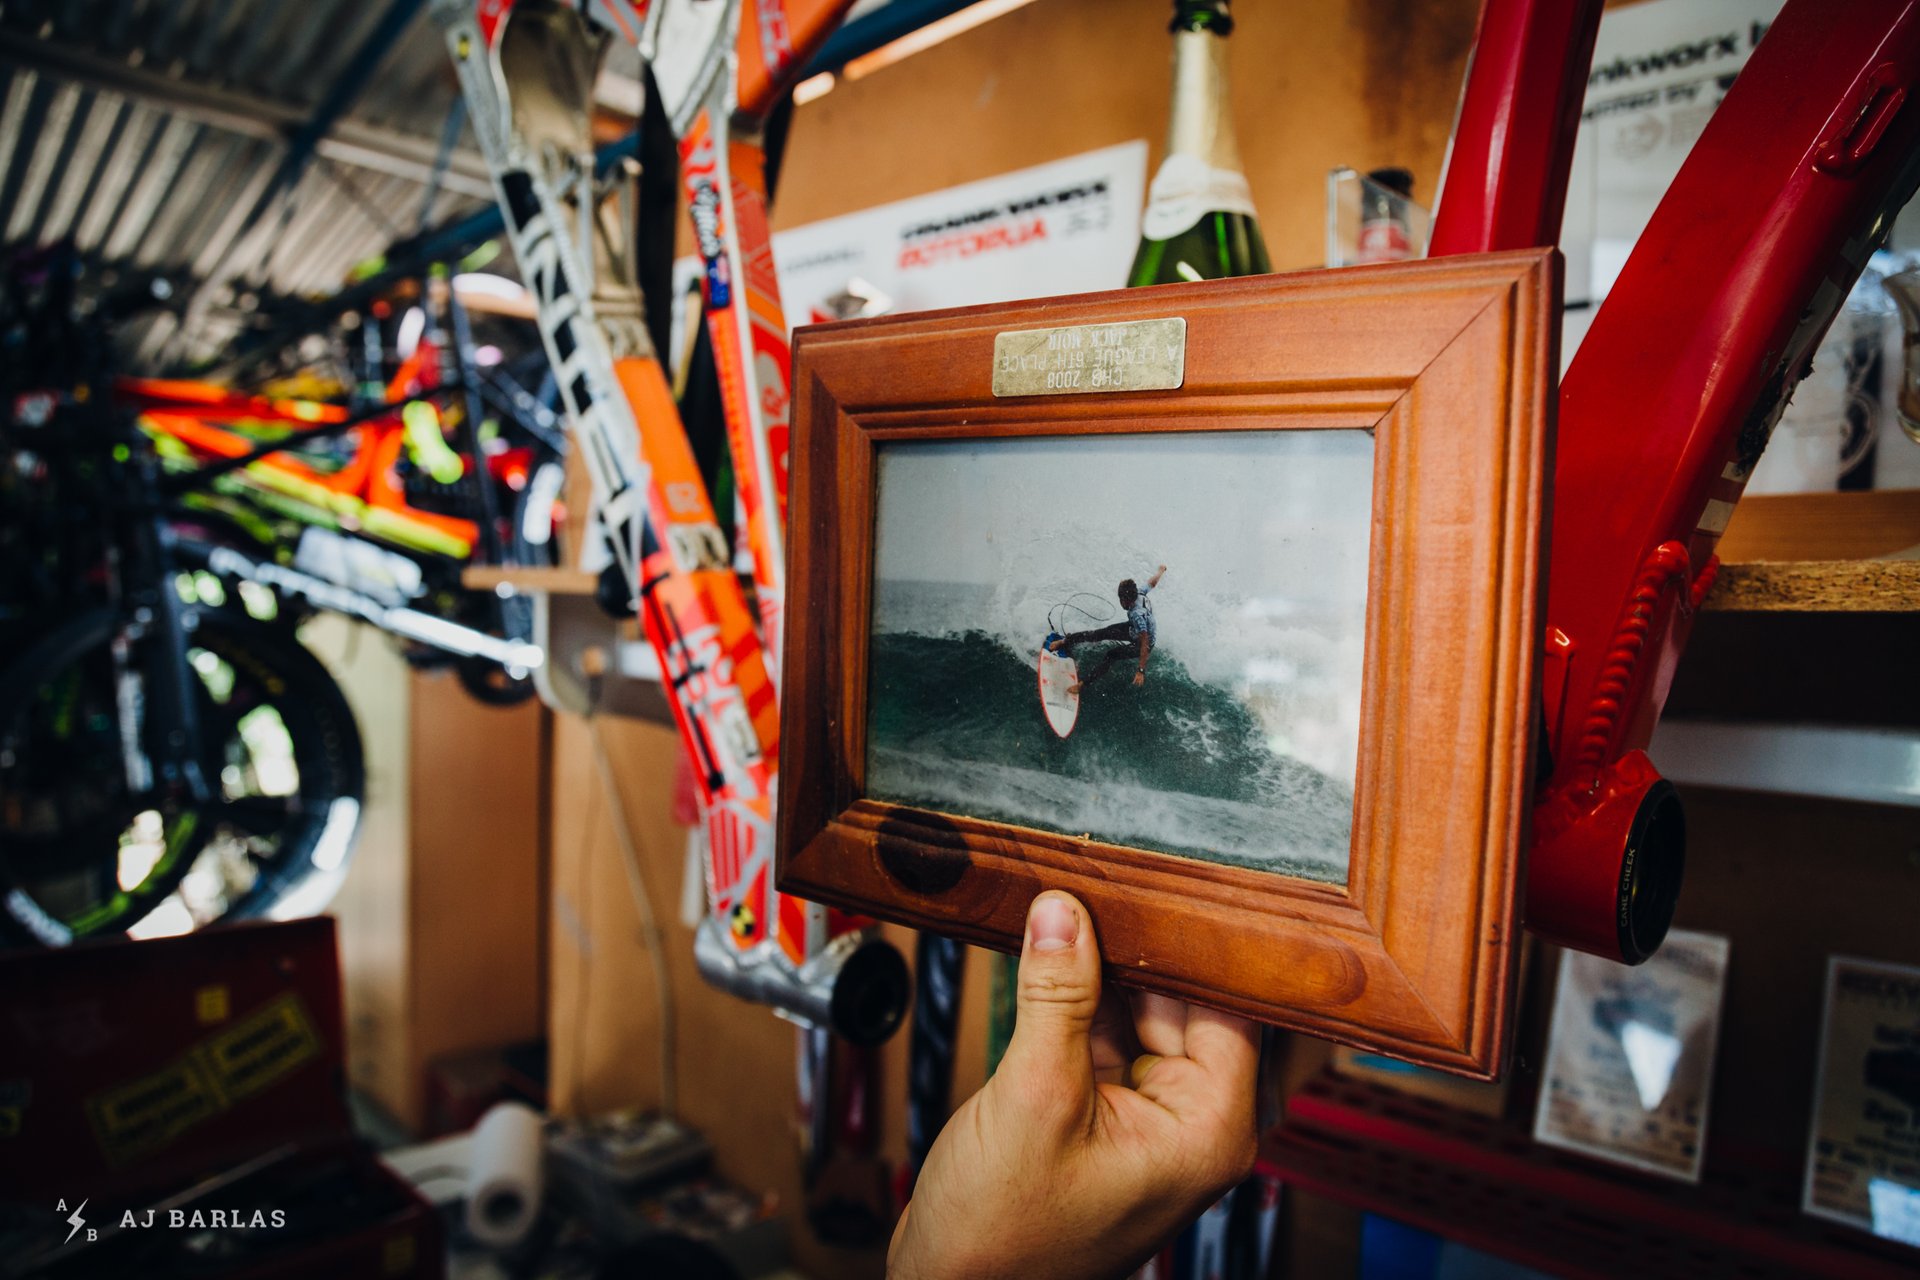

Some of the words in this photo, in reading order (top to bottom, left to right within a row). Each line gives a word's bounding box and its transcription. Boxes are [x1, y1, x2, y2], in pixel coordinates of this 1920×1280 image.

[1091, 327, 1128, 347] JACK
[1001, 353, 1047, 373] PLACE
[1056, 351, 1085, 370] 6TH
[1094, 346, 1156, 367] LEAGUE
[1167, 344, 1178, 362] A
[1047, 371, 1080, 389] 2008
[1623, 848, 1636, 891] CREEK
[1621, 895, 1629, 928] CANE
